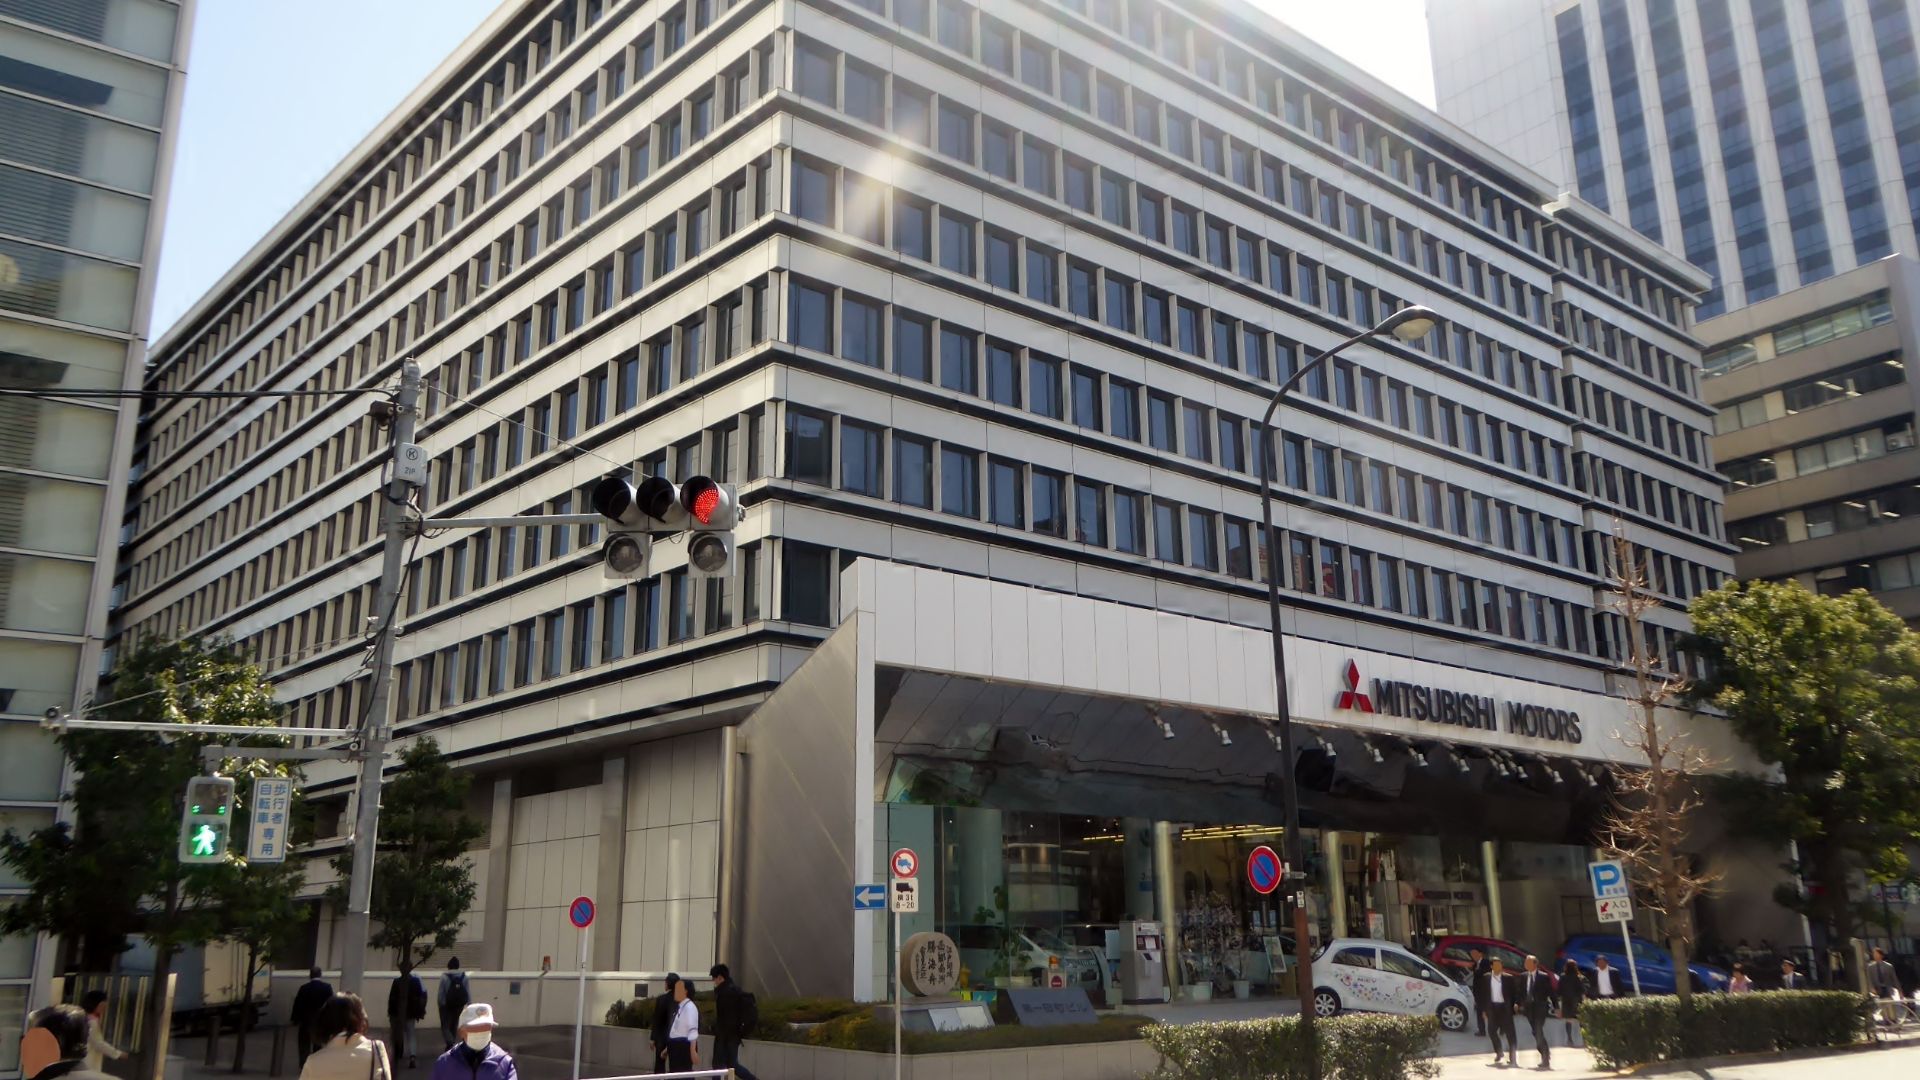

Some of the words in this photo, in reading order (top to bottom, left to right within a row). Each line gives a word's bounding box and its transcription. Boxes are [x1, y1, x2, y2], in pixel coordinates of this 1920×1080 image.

[1373, 678, 1497, 731] MITSUBISHI
[1507, 701, 1583, 744] MOTORS
[257, 783, 272, 824] 自転車
[271, 783, 288, 825] 歩行者
[262, 828, 275, 856] 専用
[1593, 864, 1620, 896] P
[1612, 900, 1628, 909] 入口
